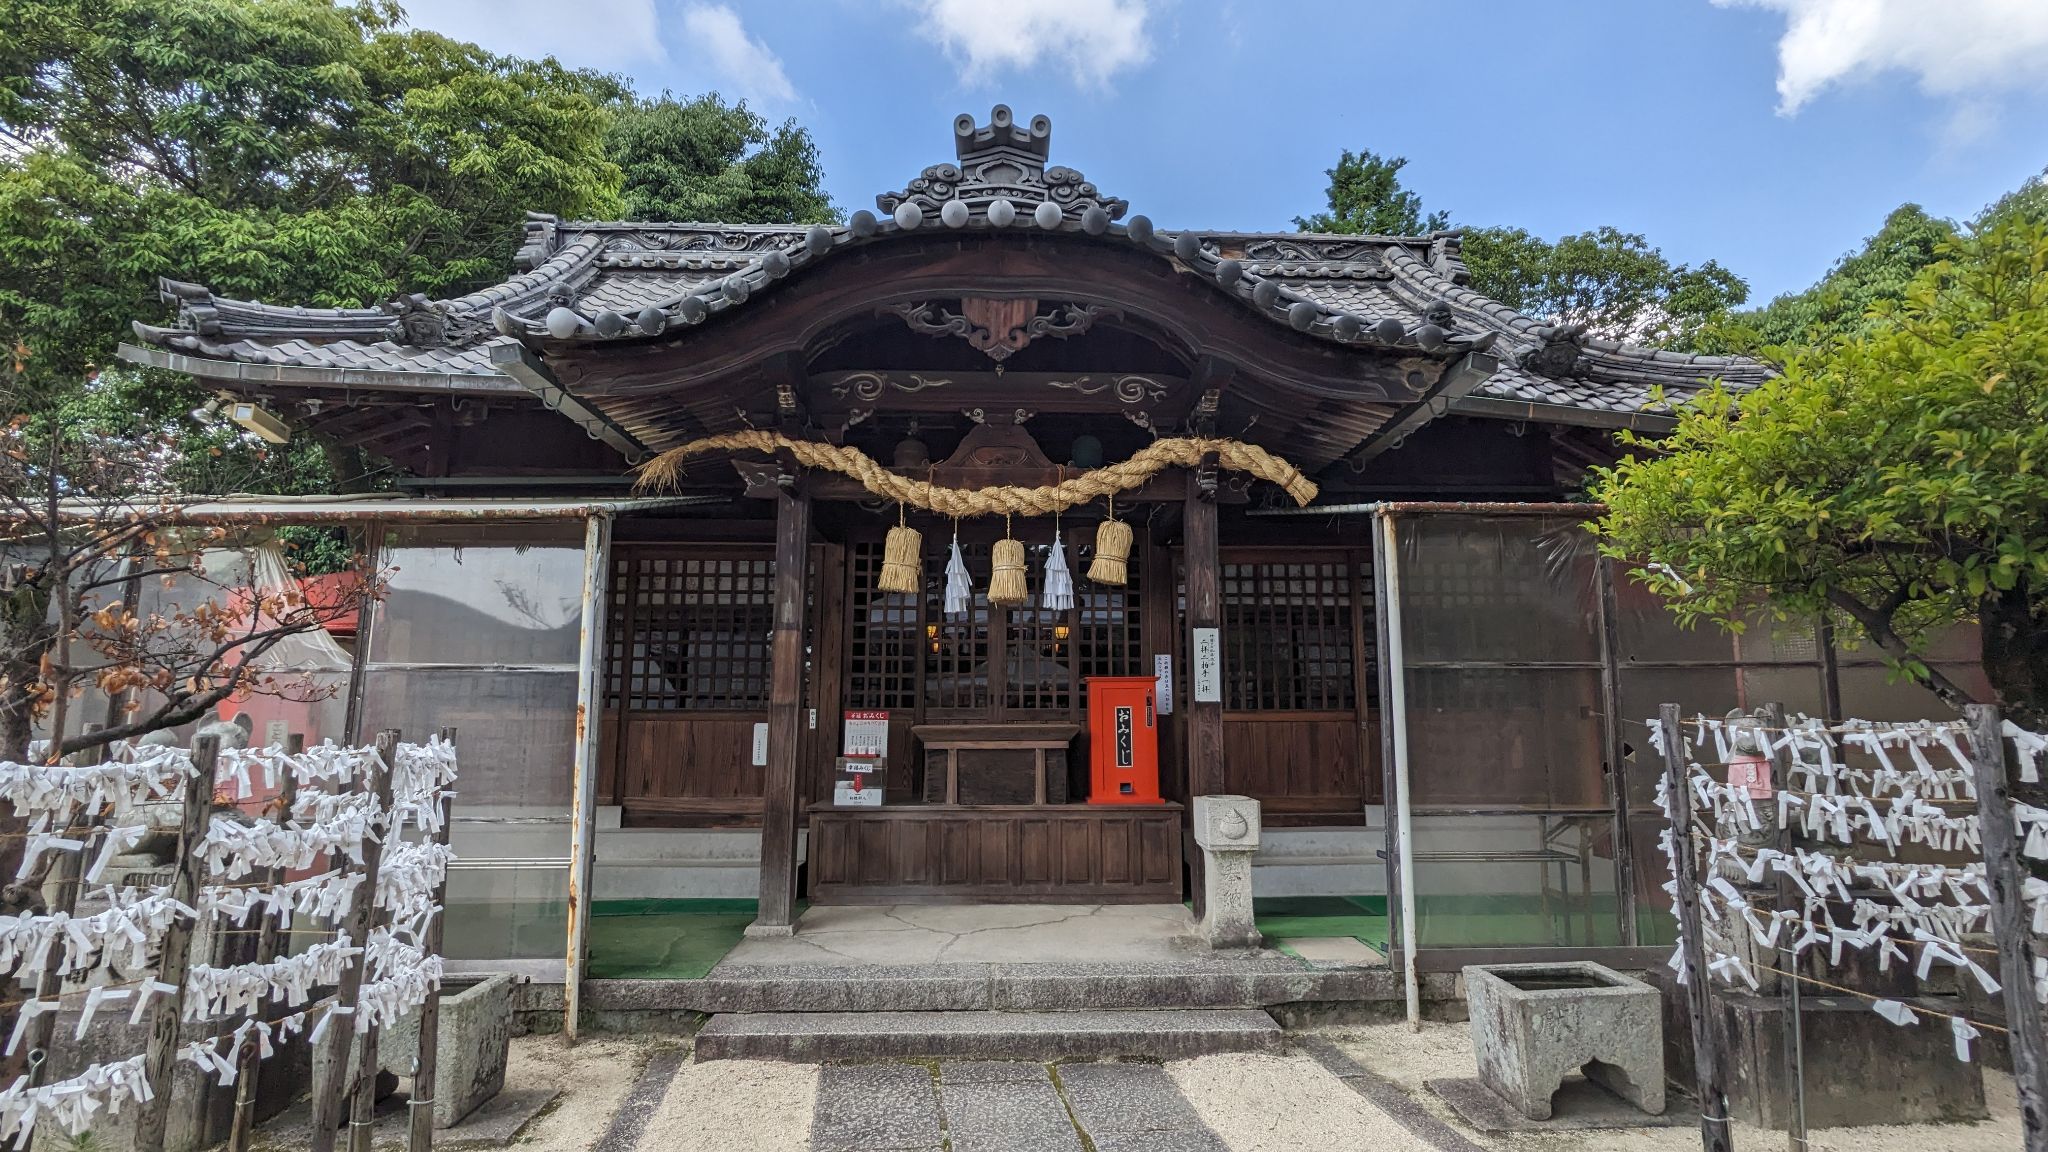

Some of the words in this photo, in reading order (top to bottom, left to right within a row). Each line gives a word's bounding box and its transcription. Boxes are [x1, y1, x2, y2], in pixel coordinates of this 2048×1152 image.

[1200, 639, 1210, 694] 二拝二拍手一拝
[1117, 709, 1130, 765] おみくじ
